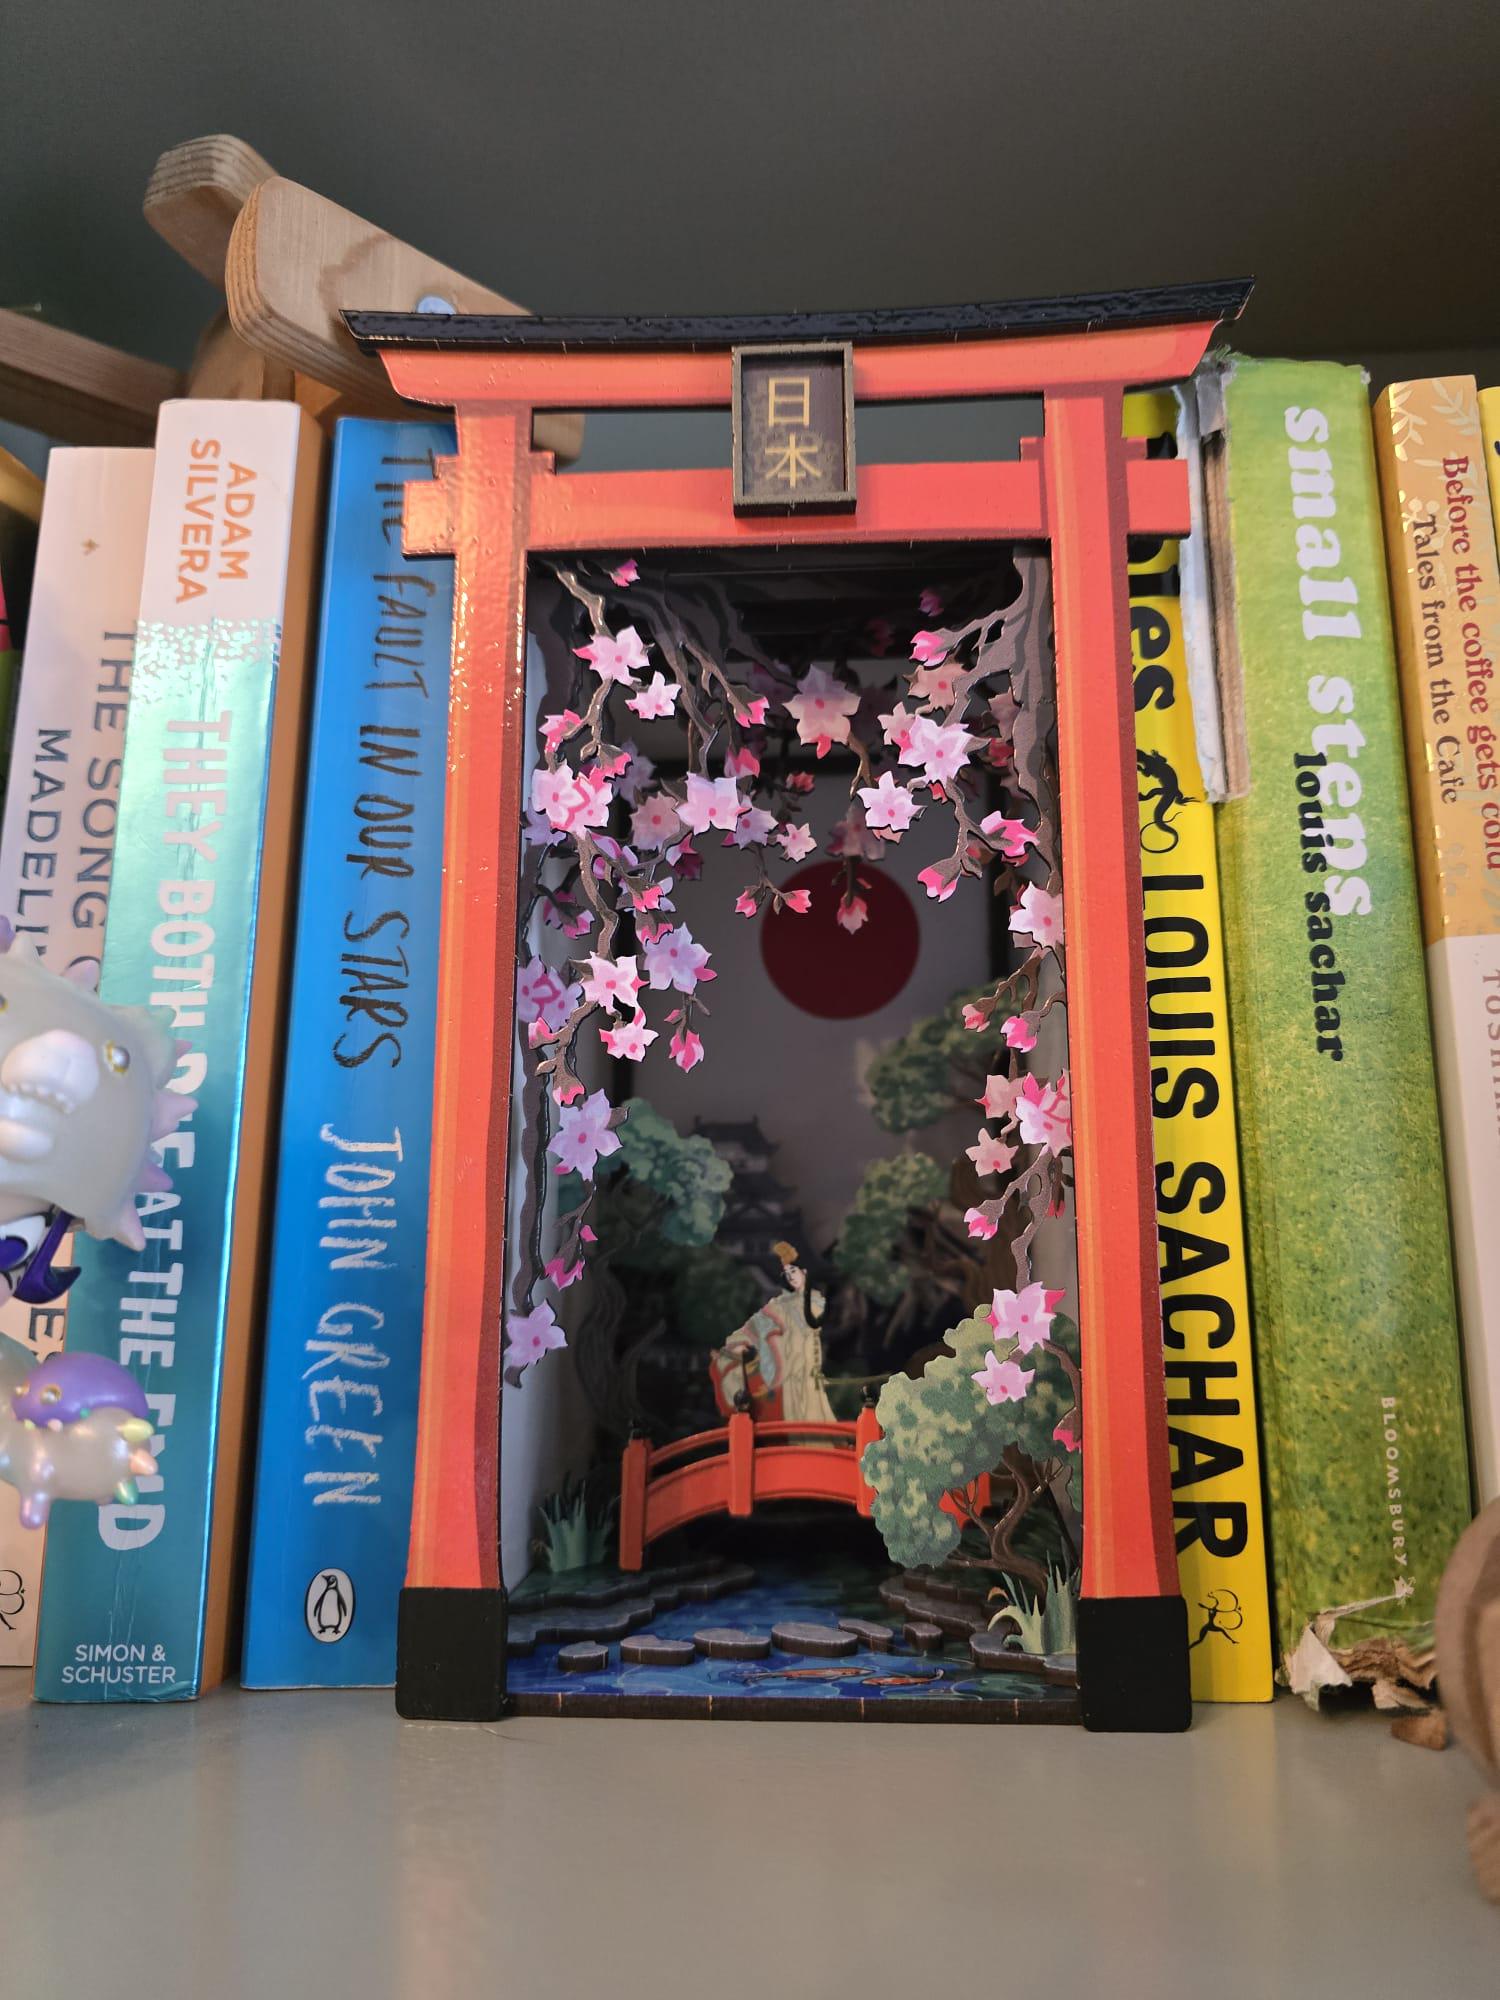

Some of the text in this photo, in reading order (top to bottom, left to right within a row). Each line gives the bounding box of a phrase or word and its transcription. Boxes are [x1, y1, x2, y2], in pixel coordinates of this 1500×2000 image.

[764, 376, 823, 489] 日本
[175, 438, 222, 604] SILVERA
[217, 461, 257, 580] ADAM
[1442, 456, 1474, 555] Before
[365, 574, 436, 698] FAULT
[1454, 563, 1484, 612] the
[1284, 405, 1373, 916] small steps
[1412, 514, 1464, 804] Tales from the Cafe
[1461, 622, 1494, 714] coffee
[163, 710, 233, 863] THEY
[359, 725, 423, 777] IN
[1467, 725, 1500, 790] gets
[15, 729, 73, 957] MADELI
[72, 757, 123, 930] SONG
[346, 793, 415, 880] OUR
[149, 880, 216, 1028] BOTH
[1293, 752, 1346, 1062] louis sachar
[333, 911, 410, 1068] STARS
[1142, 873, 1249, 1559] LOUIS SACHAR
[119, 1262, 184, 1368] THE
[301, 1123, 403, 1507] JOHN GREEN
[1381, 1396, 1408, 1567] BLOOMSBURY
[61, 1665, 176, 1684] SCHUSTER
[75, 1643, 167, 1663] SIMON &
